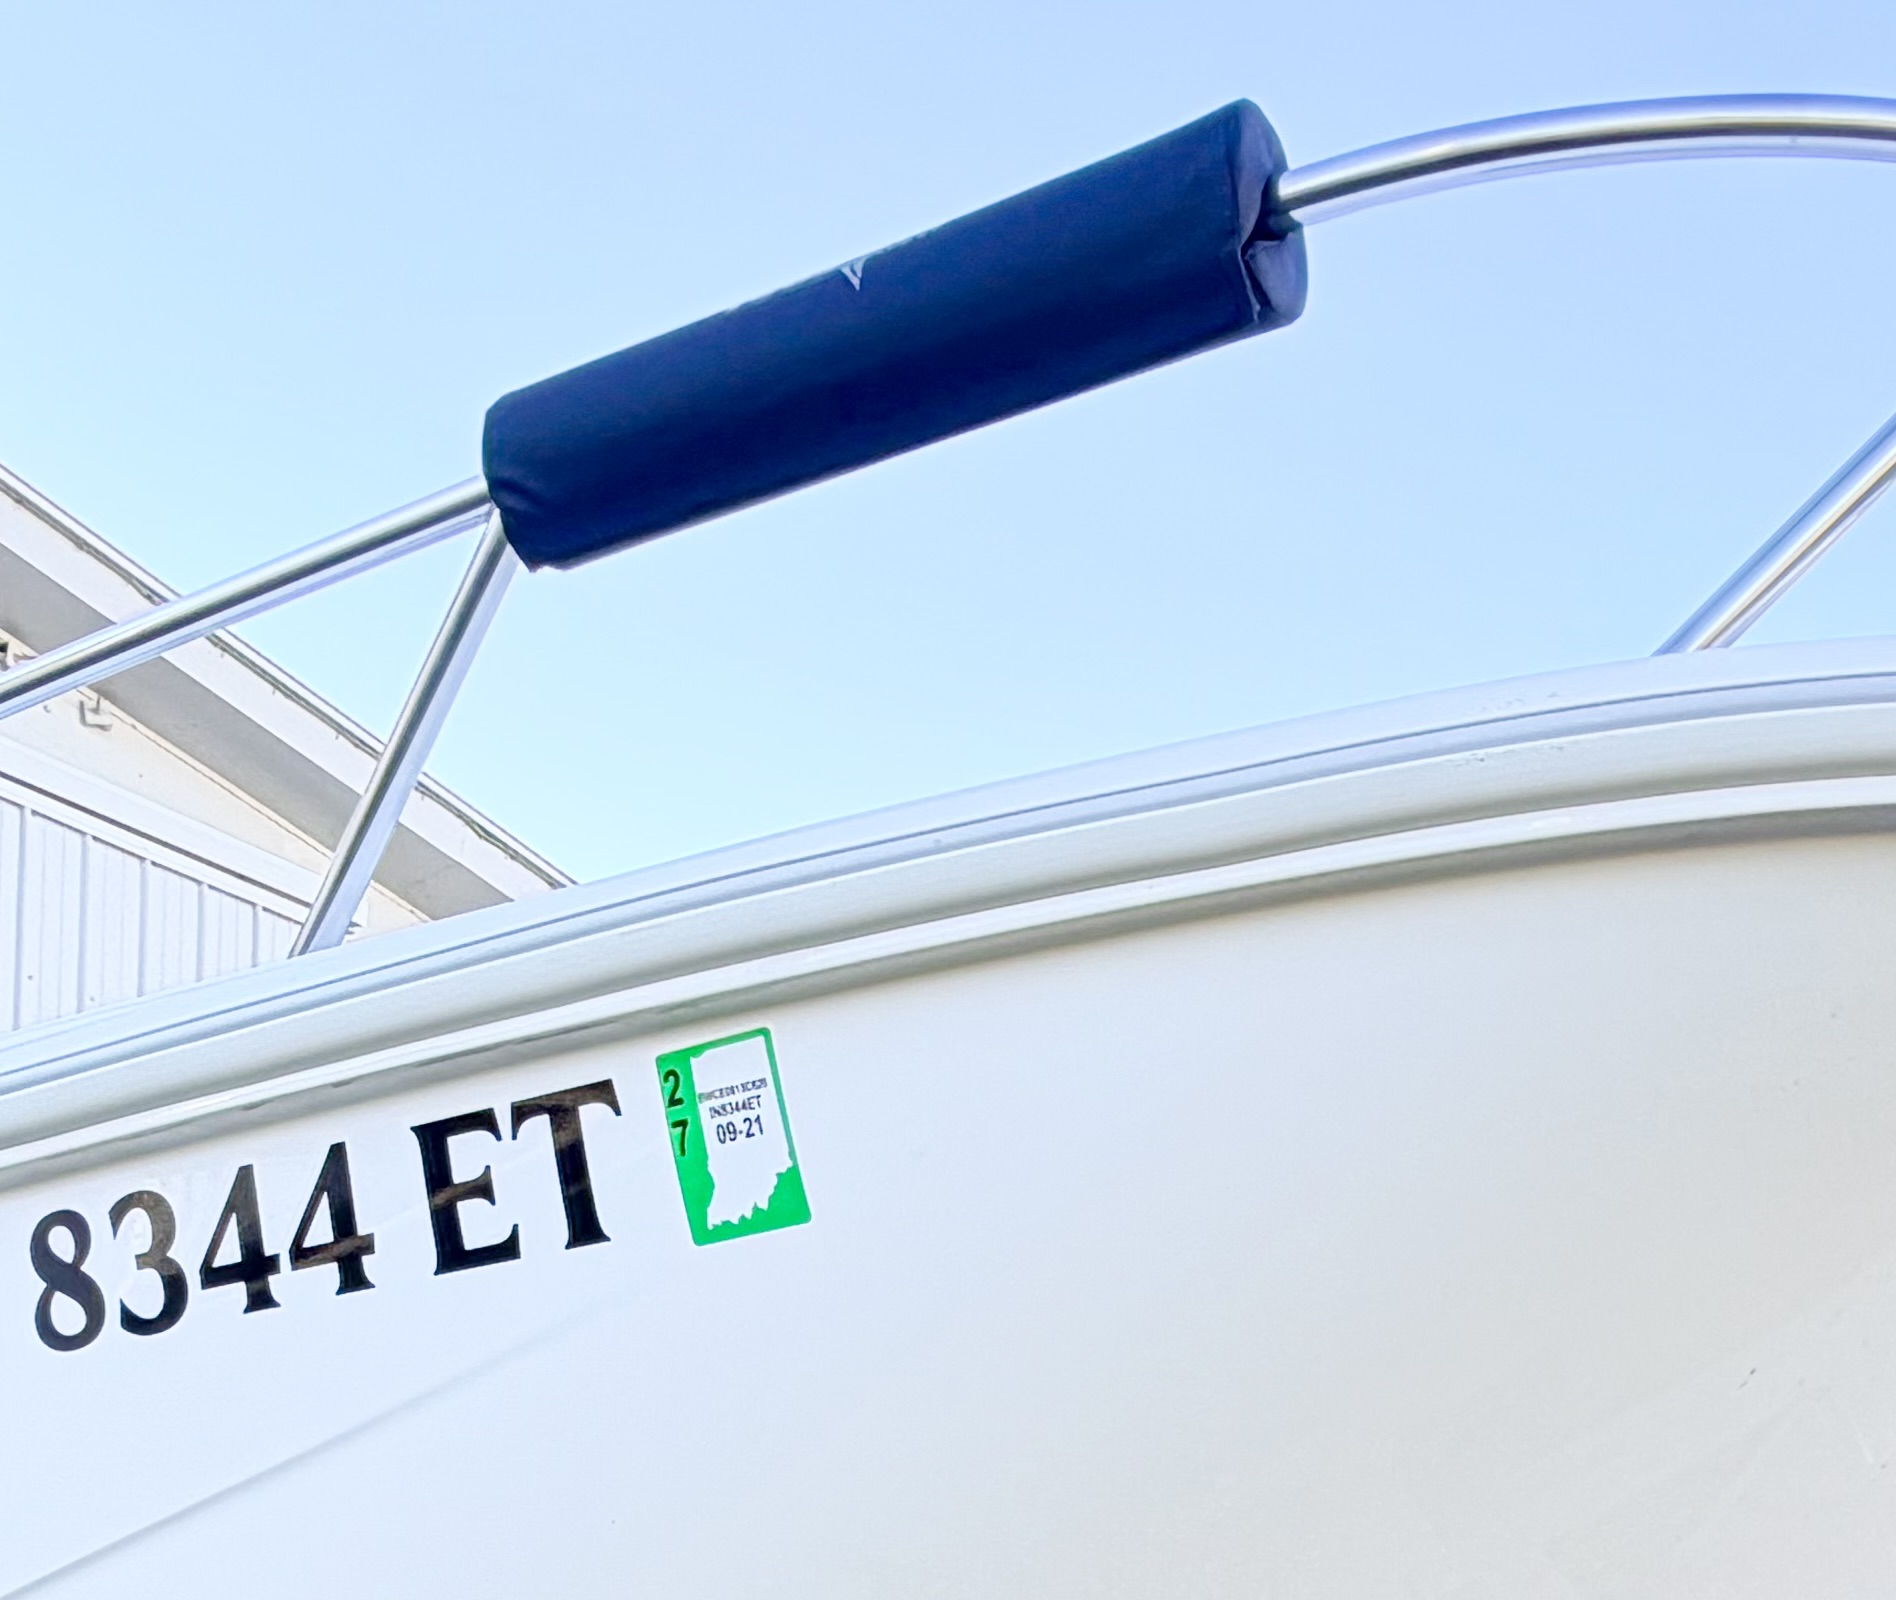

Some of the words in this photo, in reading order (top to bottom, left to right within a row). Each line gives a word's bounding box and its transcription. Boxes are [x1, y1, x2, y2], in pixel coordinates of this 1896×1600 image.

[716, 1114, 764, 1145] 09-21
[29, 1141, 376, 1352] 8344
[409, 1078, 622, 1277] ET
